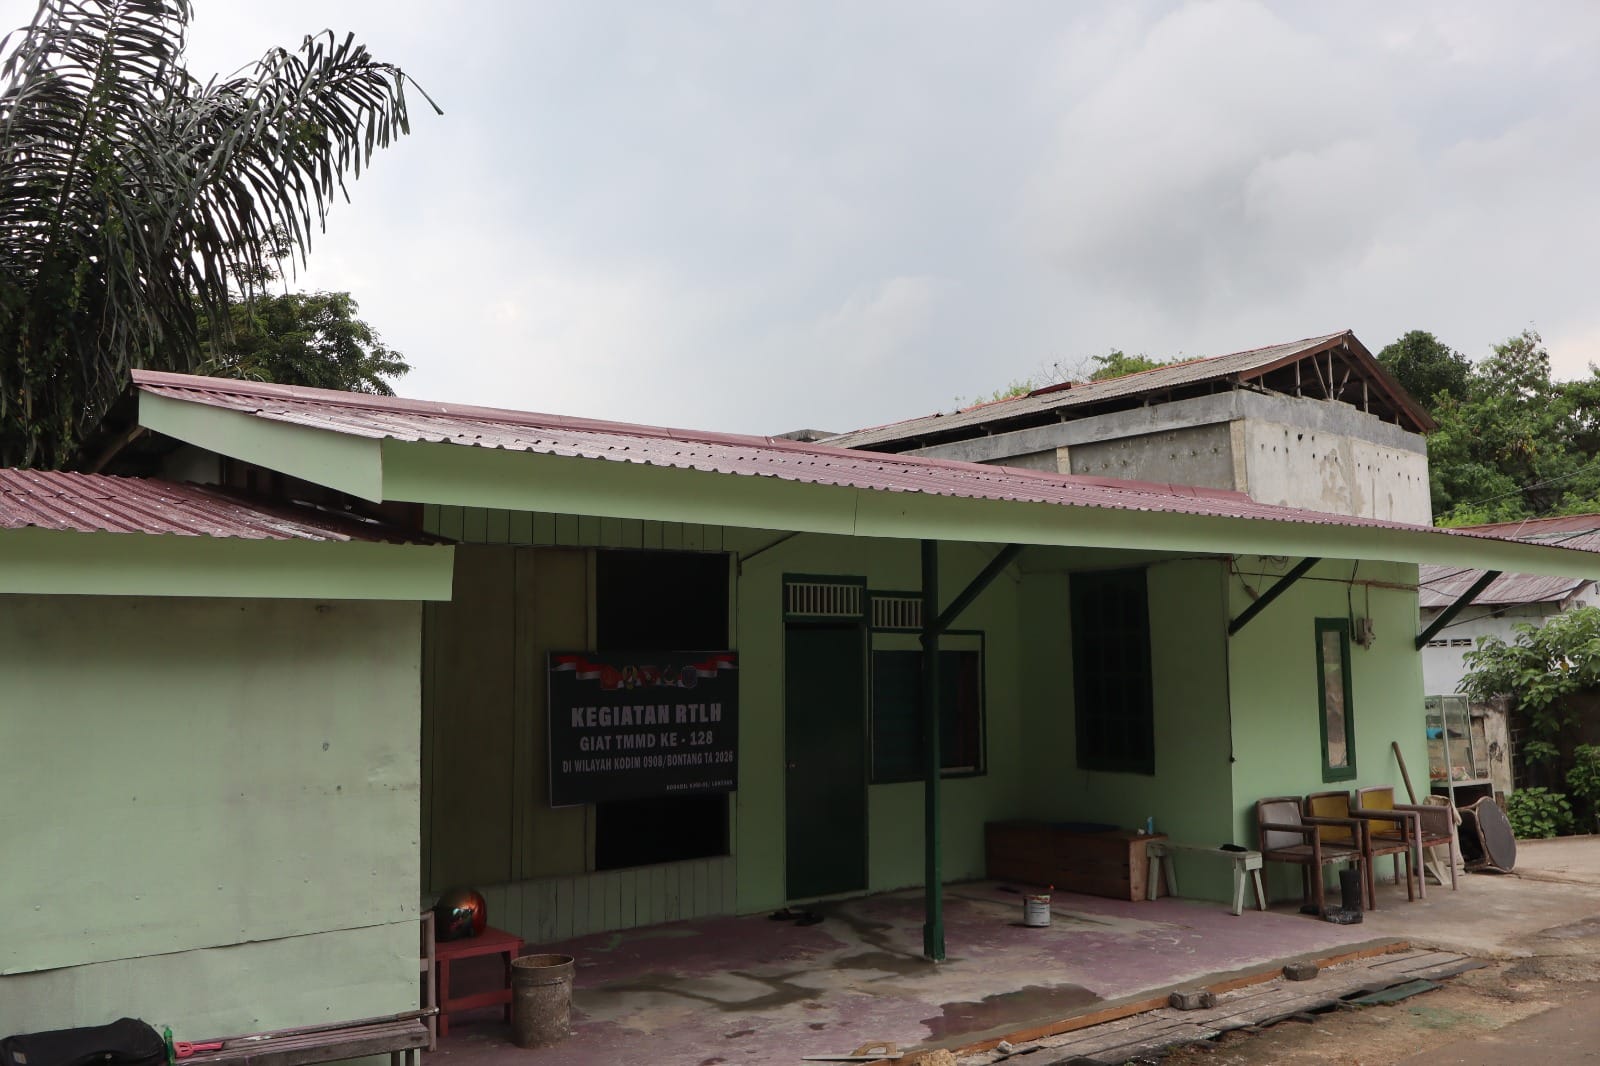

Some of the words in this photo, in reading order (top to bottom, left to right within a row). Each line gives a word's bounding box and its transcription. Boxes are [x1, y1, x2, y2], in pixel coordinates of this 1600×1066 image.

[571, 705, 670, 727] KEGIATAN
[675, 704, 721, 723] RTLH
[580, 735, 611, 751] GIAT
[616, 733, 655, 750] TMMD
[661, 732, 678, 747] KE
[690, 730, 713, 746] 128
[562, 760, 571, 773] DI
[575, 757, 611, 773] WILAYAH
[614, 756, 641, 770] KODIM
[643, 752, 702, 769] 0908/BONTANG
[704, 752, 713, 763] TA
